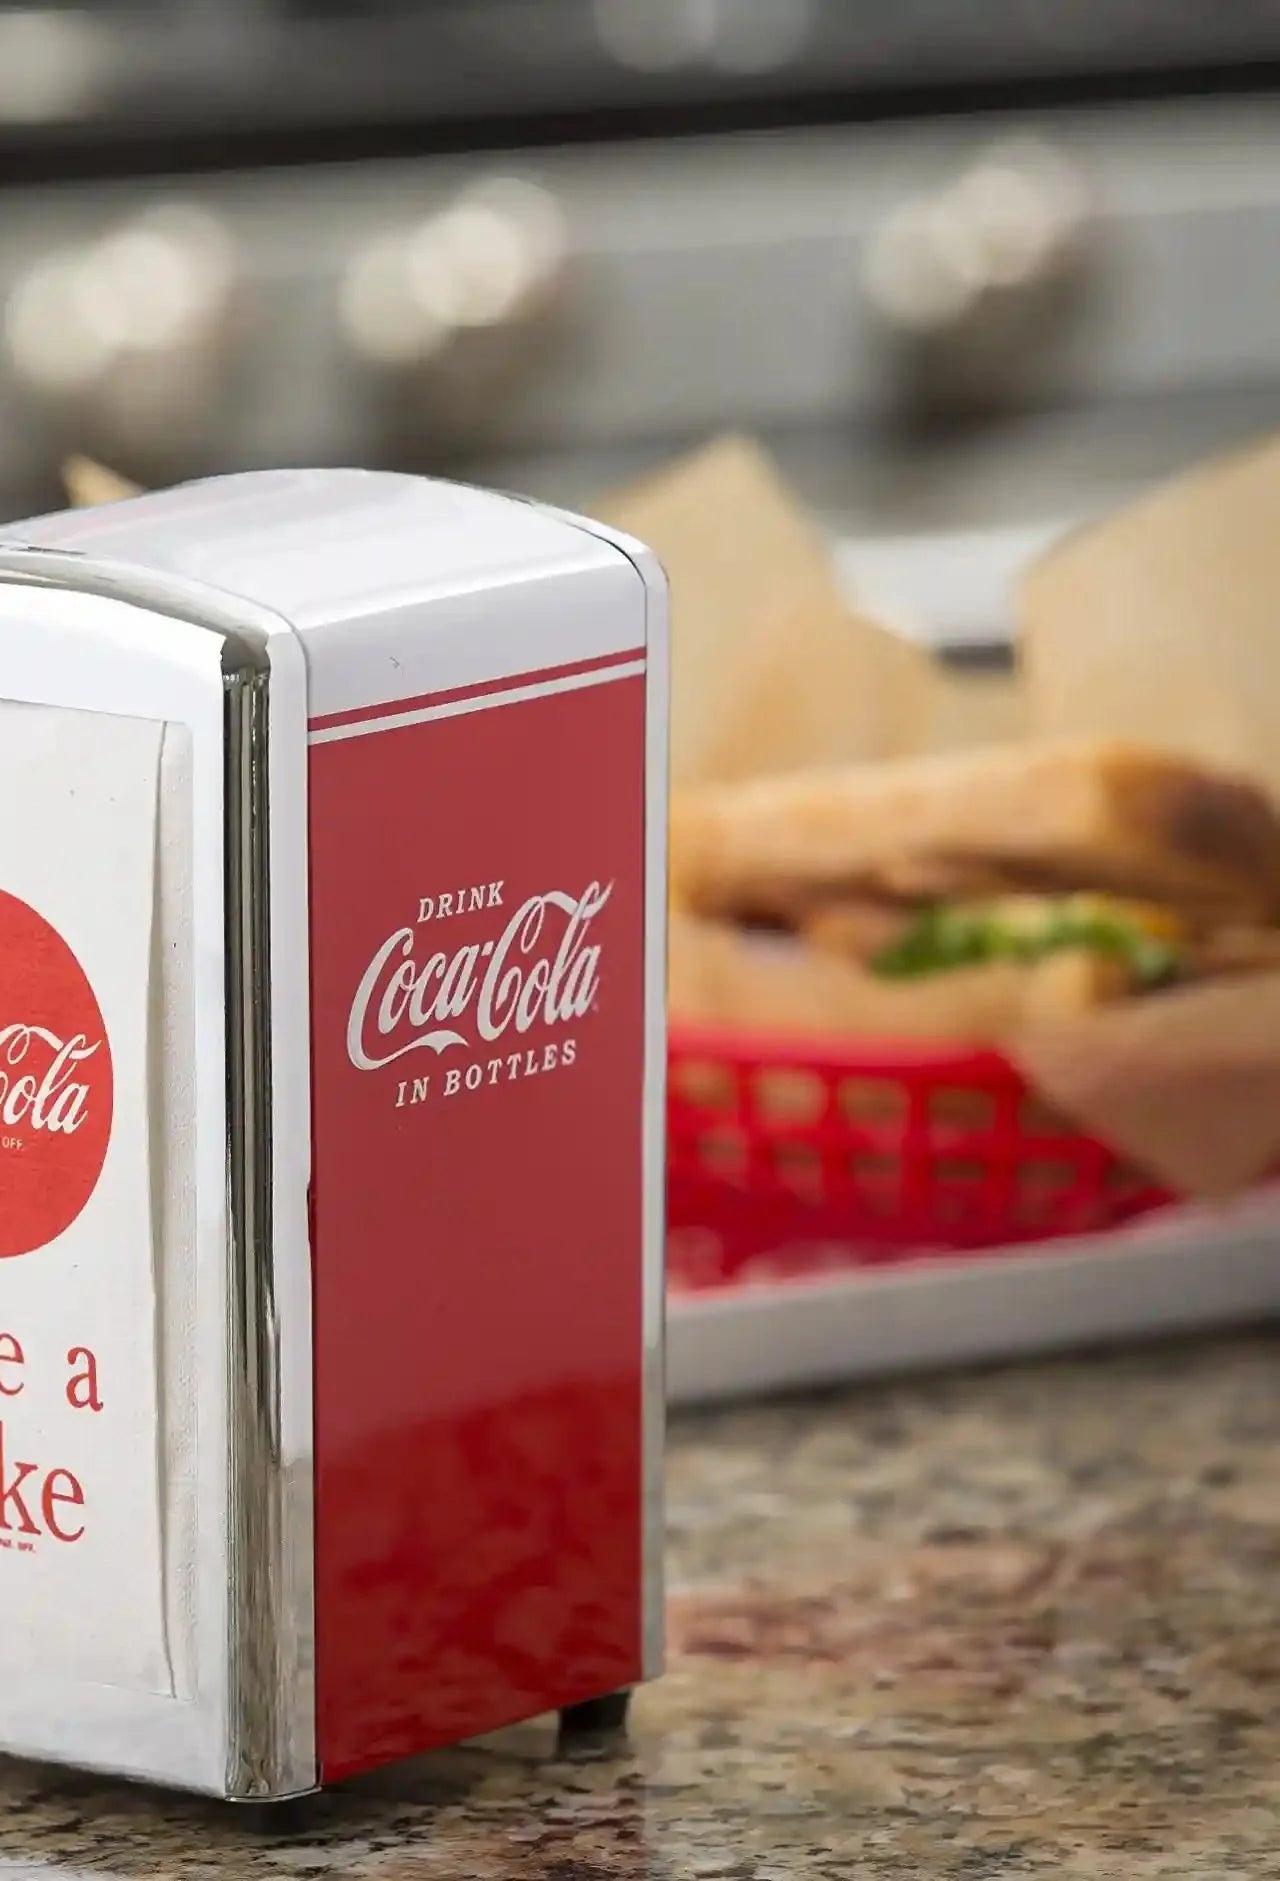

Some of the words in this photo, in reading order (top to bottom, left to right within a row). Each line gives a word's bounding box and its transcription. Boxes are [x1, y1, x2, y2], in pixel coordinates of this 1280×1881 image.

[417, 880, 505, 923] DRINK
[347, 879, 614, 1070] Coca-Cola
[395, 1077, 429, 1108] IN
[444, 1039, 577, 1096] BOTTLES
[66, 1347, 104, 1412] a
